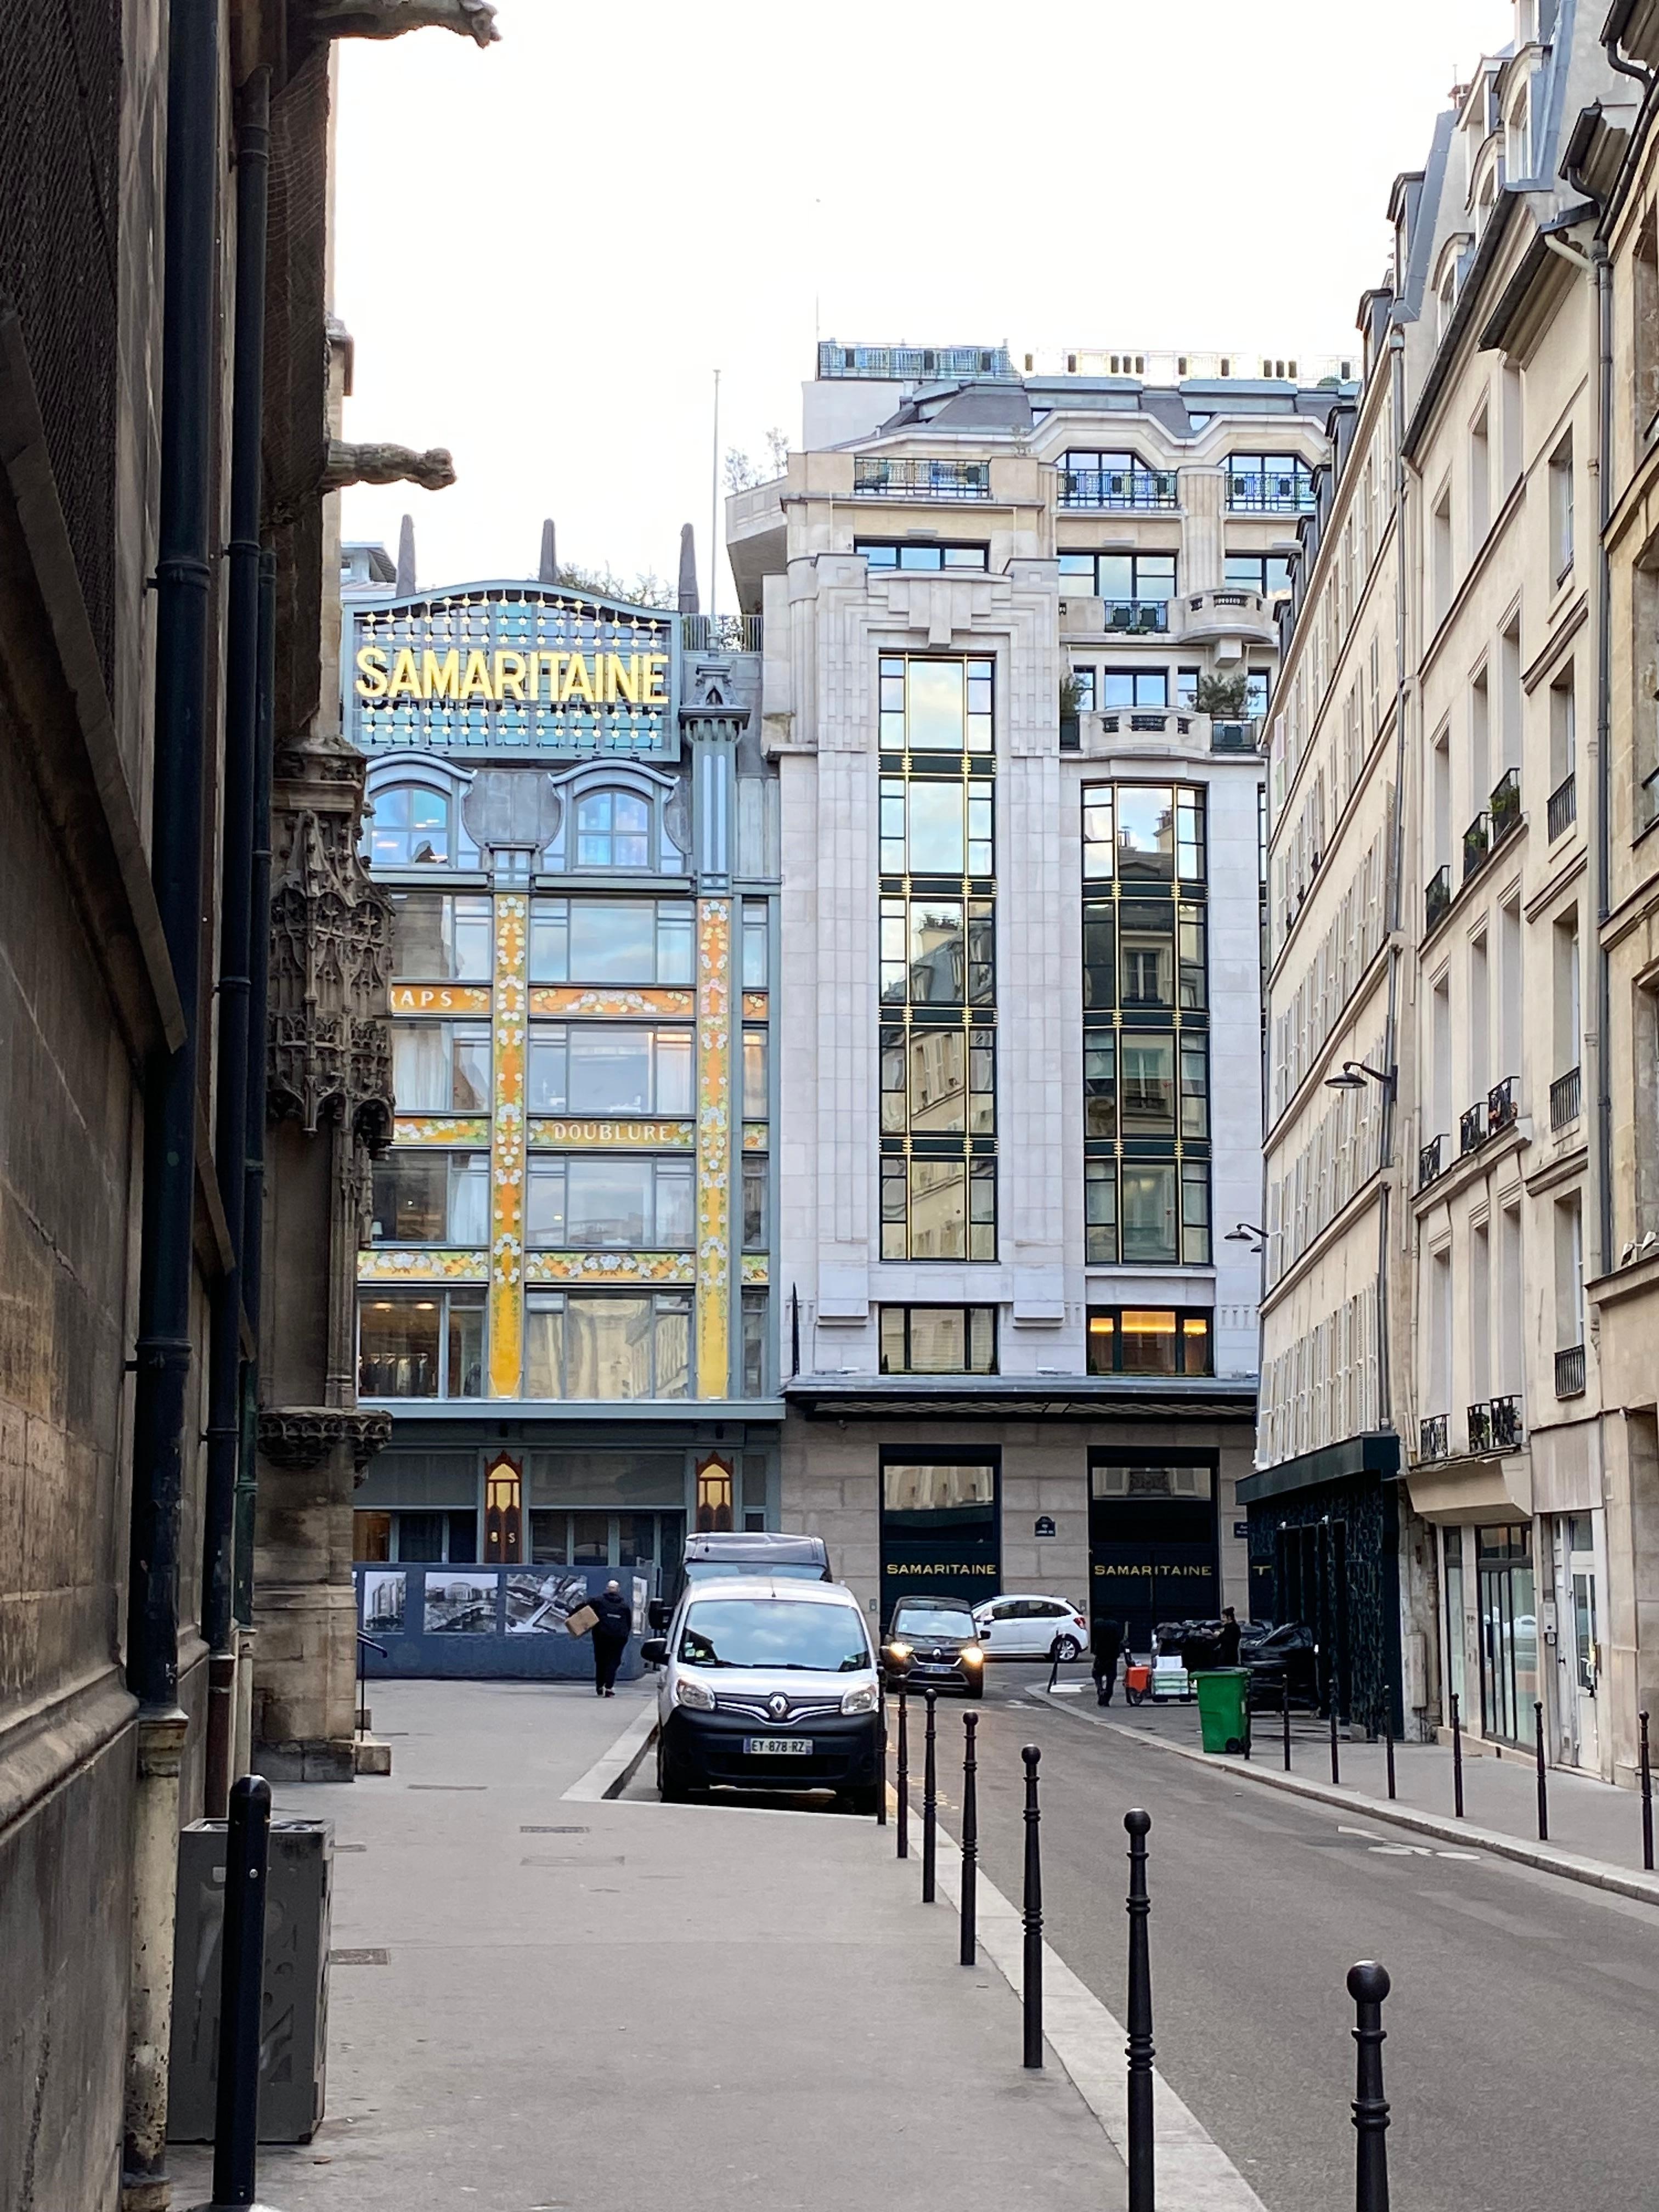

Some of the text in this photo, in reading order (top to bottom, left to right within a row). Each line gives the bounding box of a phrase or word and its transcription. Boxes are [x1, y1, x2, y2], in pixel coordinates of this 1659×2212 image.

[356, 646, 669, 704] SAMARITAINE
[552, 1123, 671, 1141] DOUBLURE
[887, 1564, 997, 1575] SAMARITAINE
[1094, 1565, 1212, 1576] SAMARITAINE
